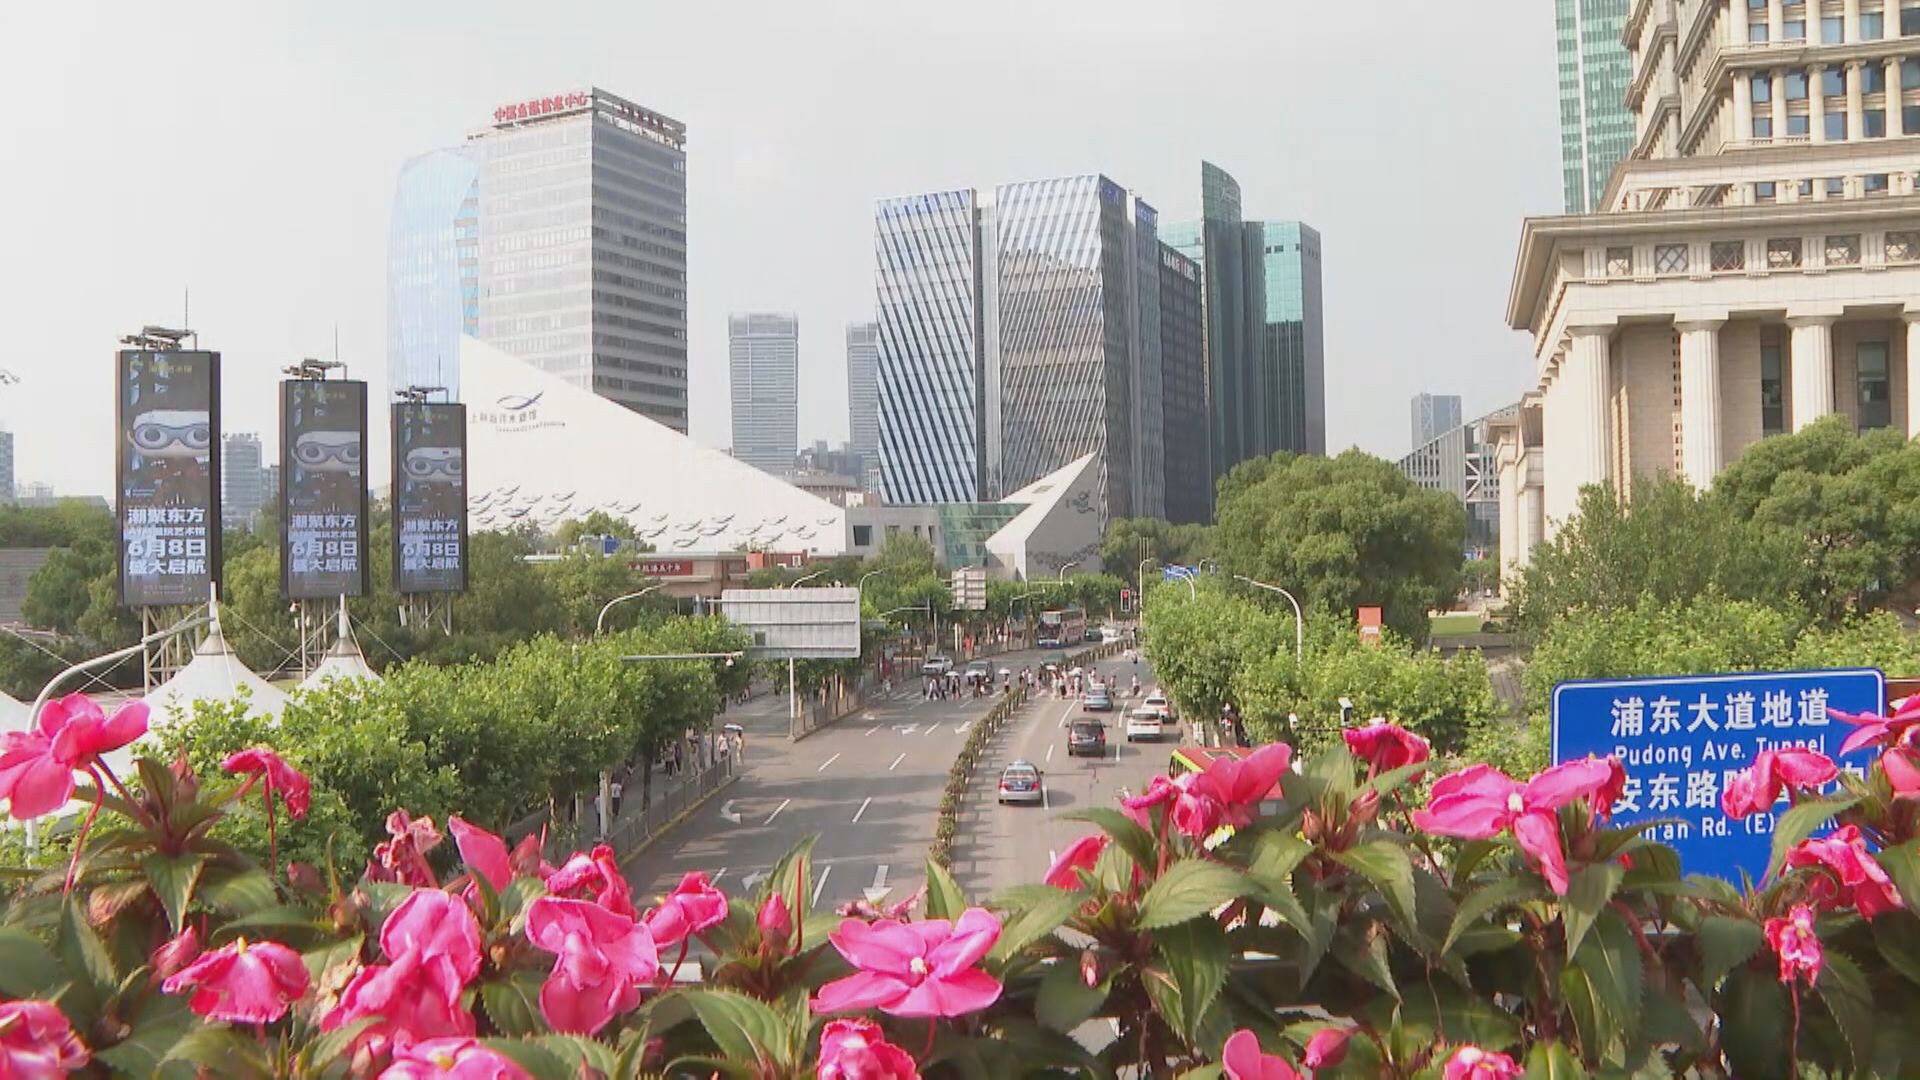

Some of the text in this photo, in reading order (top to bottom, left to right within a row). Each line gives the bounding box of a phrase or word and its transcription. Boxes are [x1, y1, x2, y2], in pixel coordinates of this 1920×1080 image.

[128, 507, 205, 524] 潮聚东方
[292, 514, 357, 529] 潮聚东方
[128, 538, 206, 559] 6月8日
[292, 540, 357, 557] 6月8日
[403, 542, 460, 557] 6月8日
[128, 558, 207, 575] 盛大启航
[1610, 687, 1830, 737] 浦东大道地道
[1614, 742, 1693, 768] Pudong
[1702, 739, 1746, 761] Ave.
[1702, 816, 1732, 838] Rd.
[1744, 812, 1775, 835] (E)
